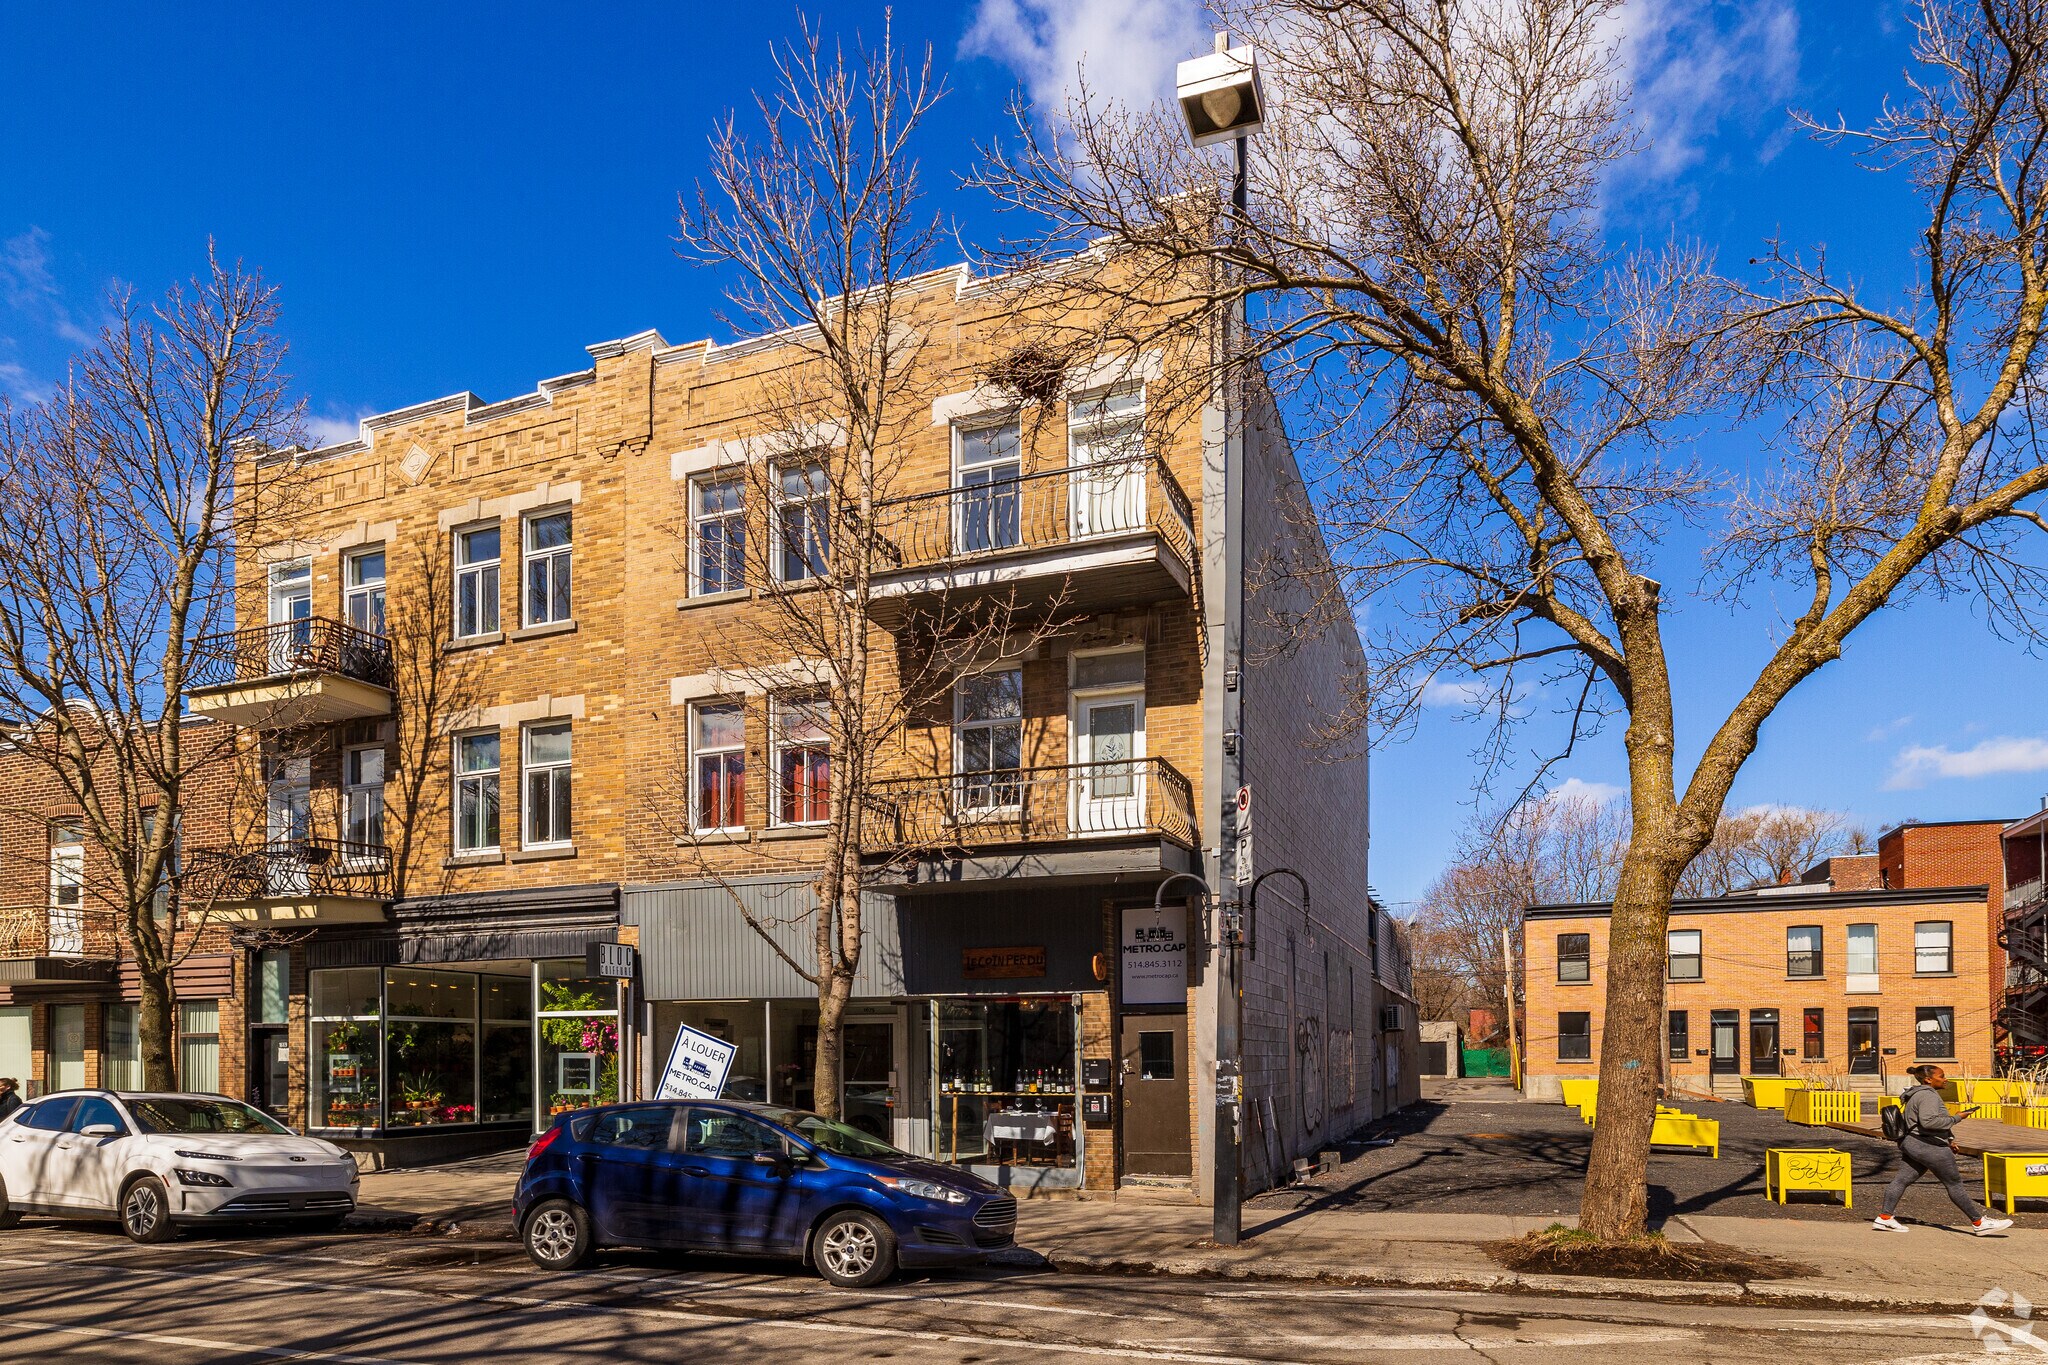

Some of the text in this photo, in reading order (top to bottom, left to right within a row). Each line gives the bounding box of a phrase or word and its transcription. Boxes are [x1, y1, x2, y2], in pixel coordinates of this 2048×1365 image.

[1241, 839, 1247, 856] P
[601, 945, 631, 966] BLOC
[1123, 943, 1186, 954] METRO.CAP
[600, 965, 631, 976] COIFFURE
[1128, 960, 1182, 969] 514.845.3112
[681, 1035, 726, 1064] À LOUER
[668, 1067, 717, 1093] METRO.CAP
[664, 1083, 699, 1099] 514.845
